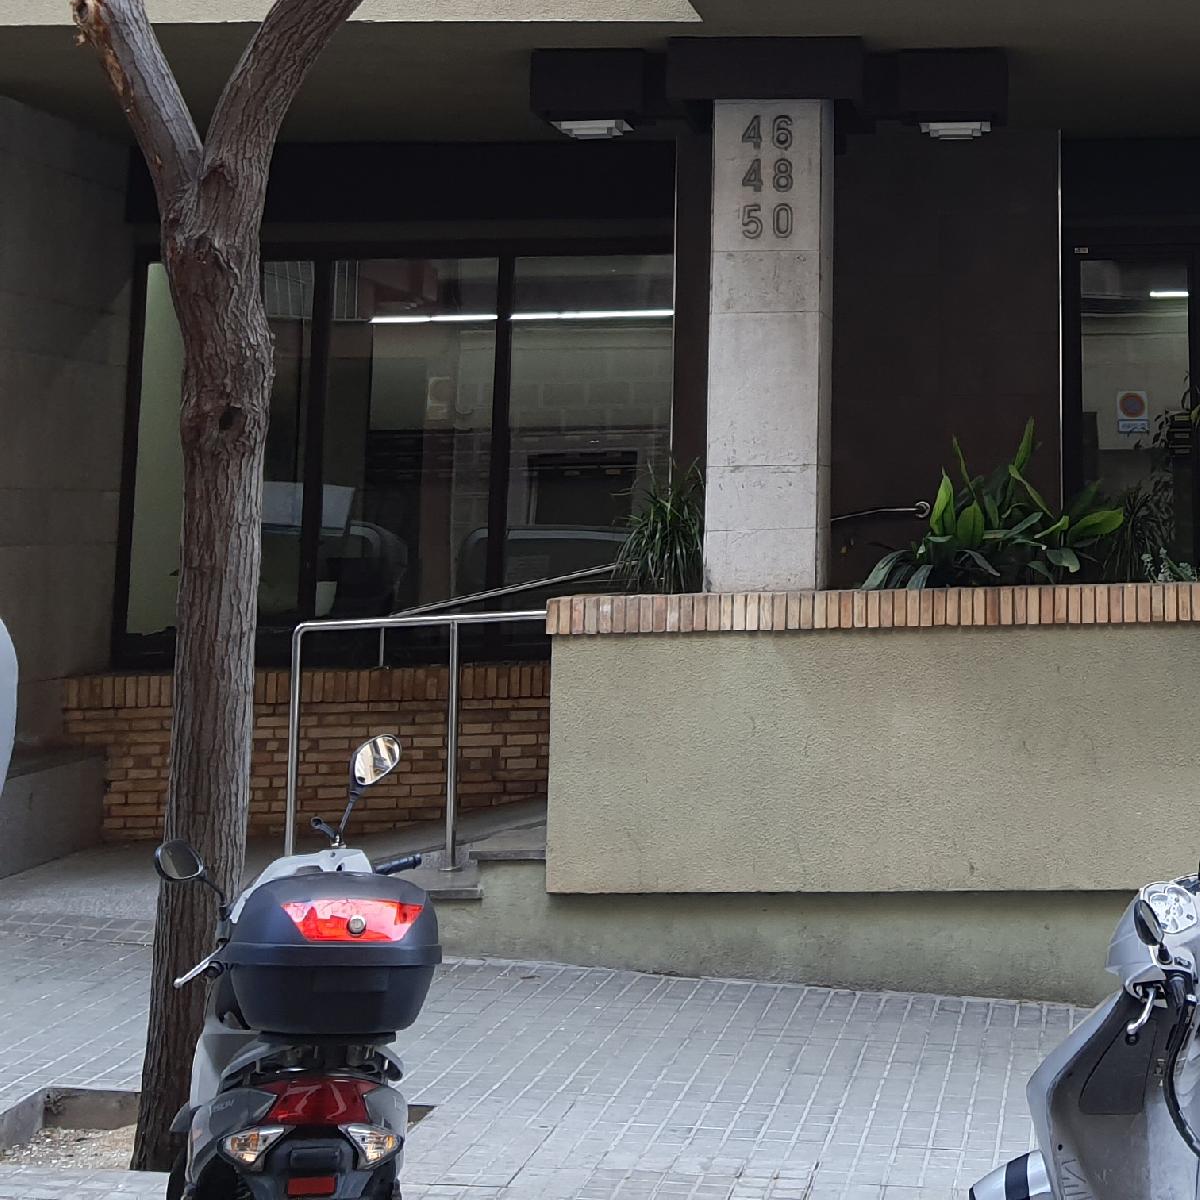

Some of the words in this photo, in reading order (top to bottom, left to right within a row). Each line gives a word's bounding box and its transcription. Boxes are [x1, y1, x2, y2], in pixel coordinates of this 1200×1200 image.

[741, 114, 793, 150] 46
[741, 158, 794, 193] 48
[741, 203, 793, 239] 50
